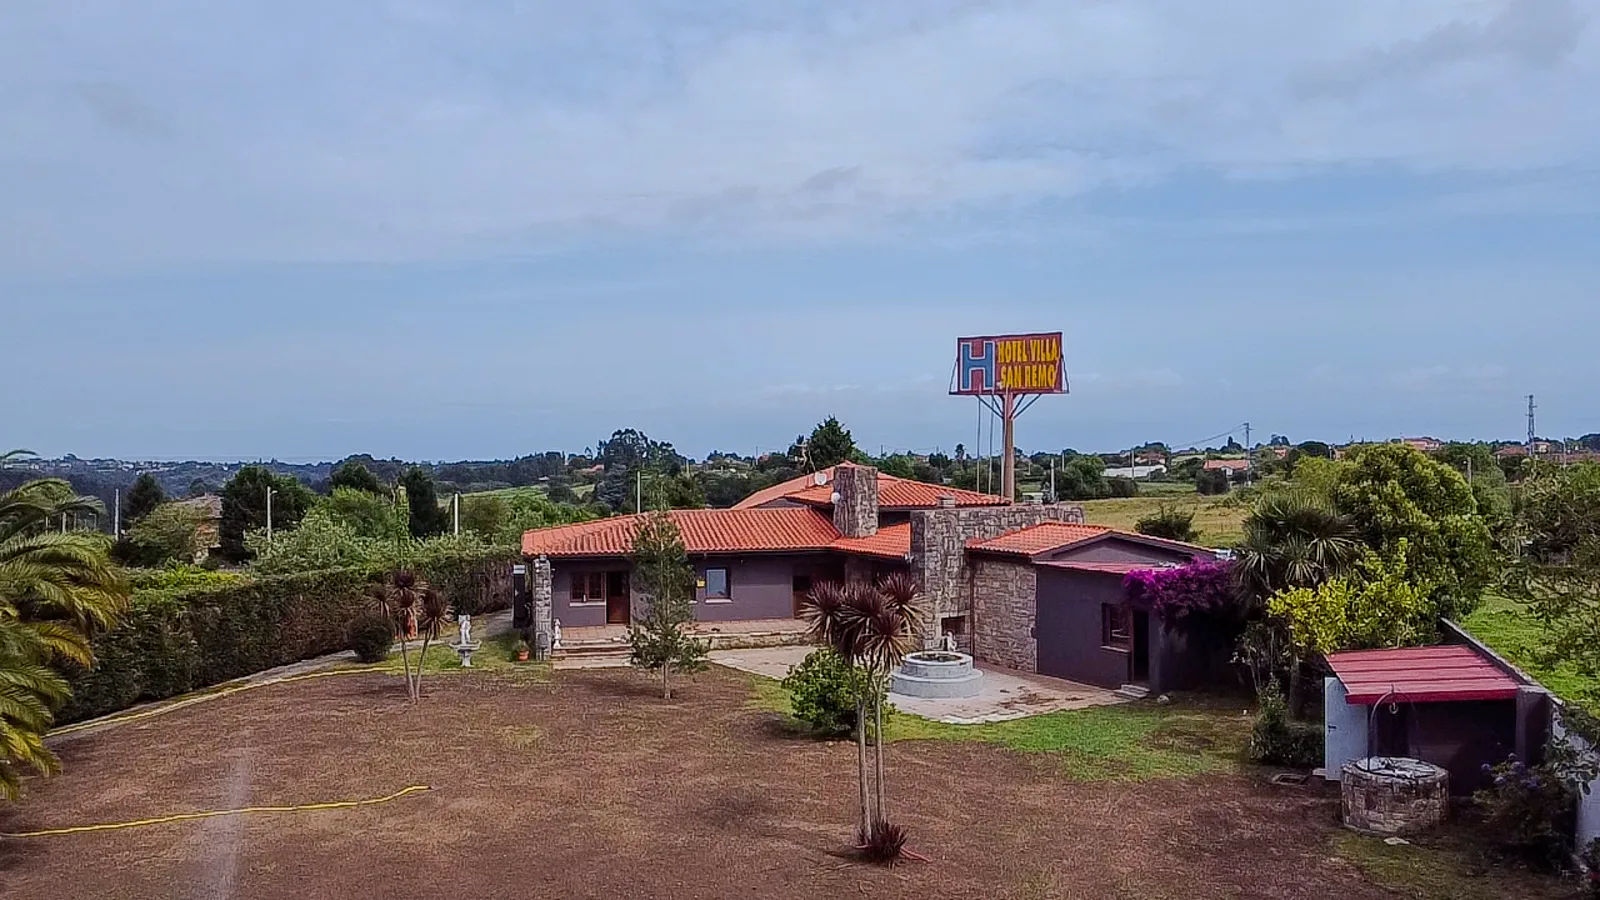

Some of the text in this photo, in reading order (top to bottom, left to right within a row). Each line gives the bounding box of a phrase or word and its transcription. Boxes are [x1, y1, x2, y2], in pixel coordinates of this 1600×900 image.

[997, 338, 1059, 363] HOTEL VILLA
[1000, 364, 1056, 388] SAN REMO
